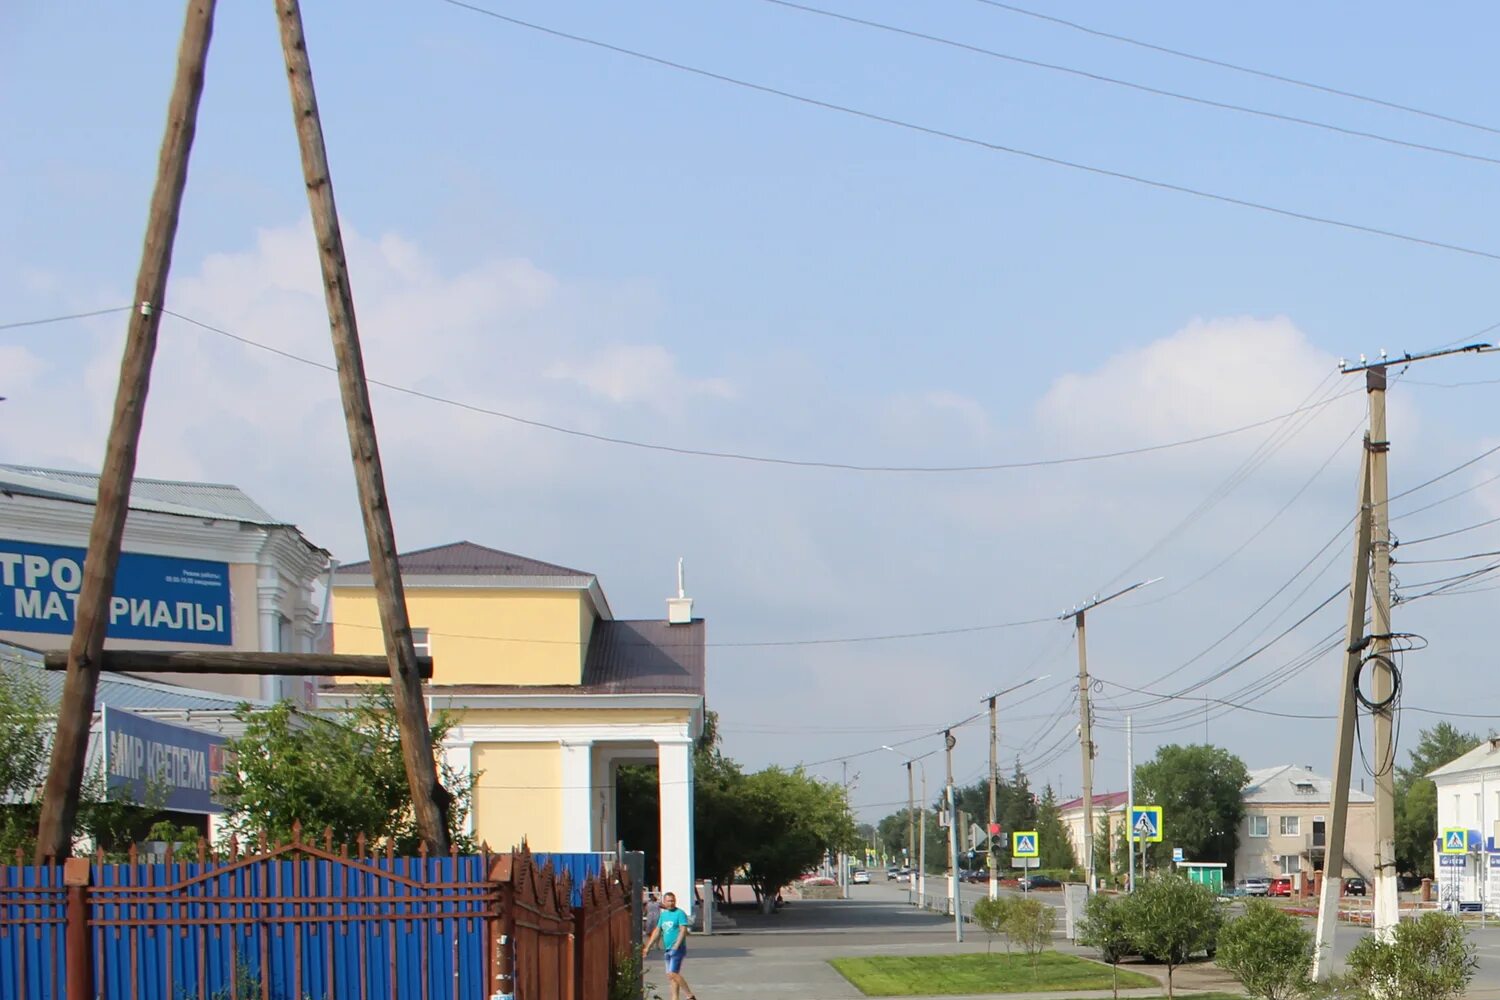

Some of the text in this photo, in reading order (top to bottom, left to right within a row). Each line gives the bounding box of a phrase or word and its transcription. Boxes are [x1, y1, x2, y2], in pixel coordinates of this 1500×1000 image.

[14, 588, 224, 632] МАТРИАЛЫ
[110, 730, 144, 780] МИР
[147, 740, 207, 791] КРЕПЕЖА
